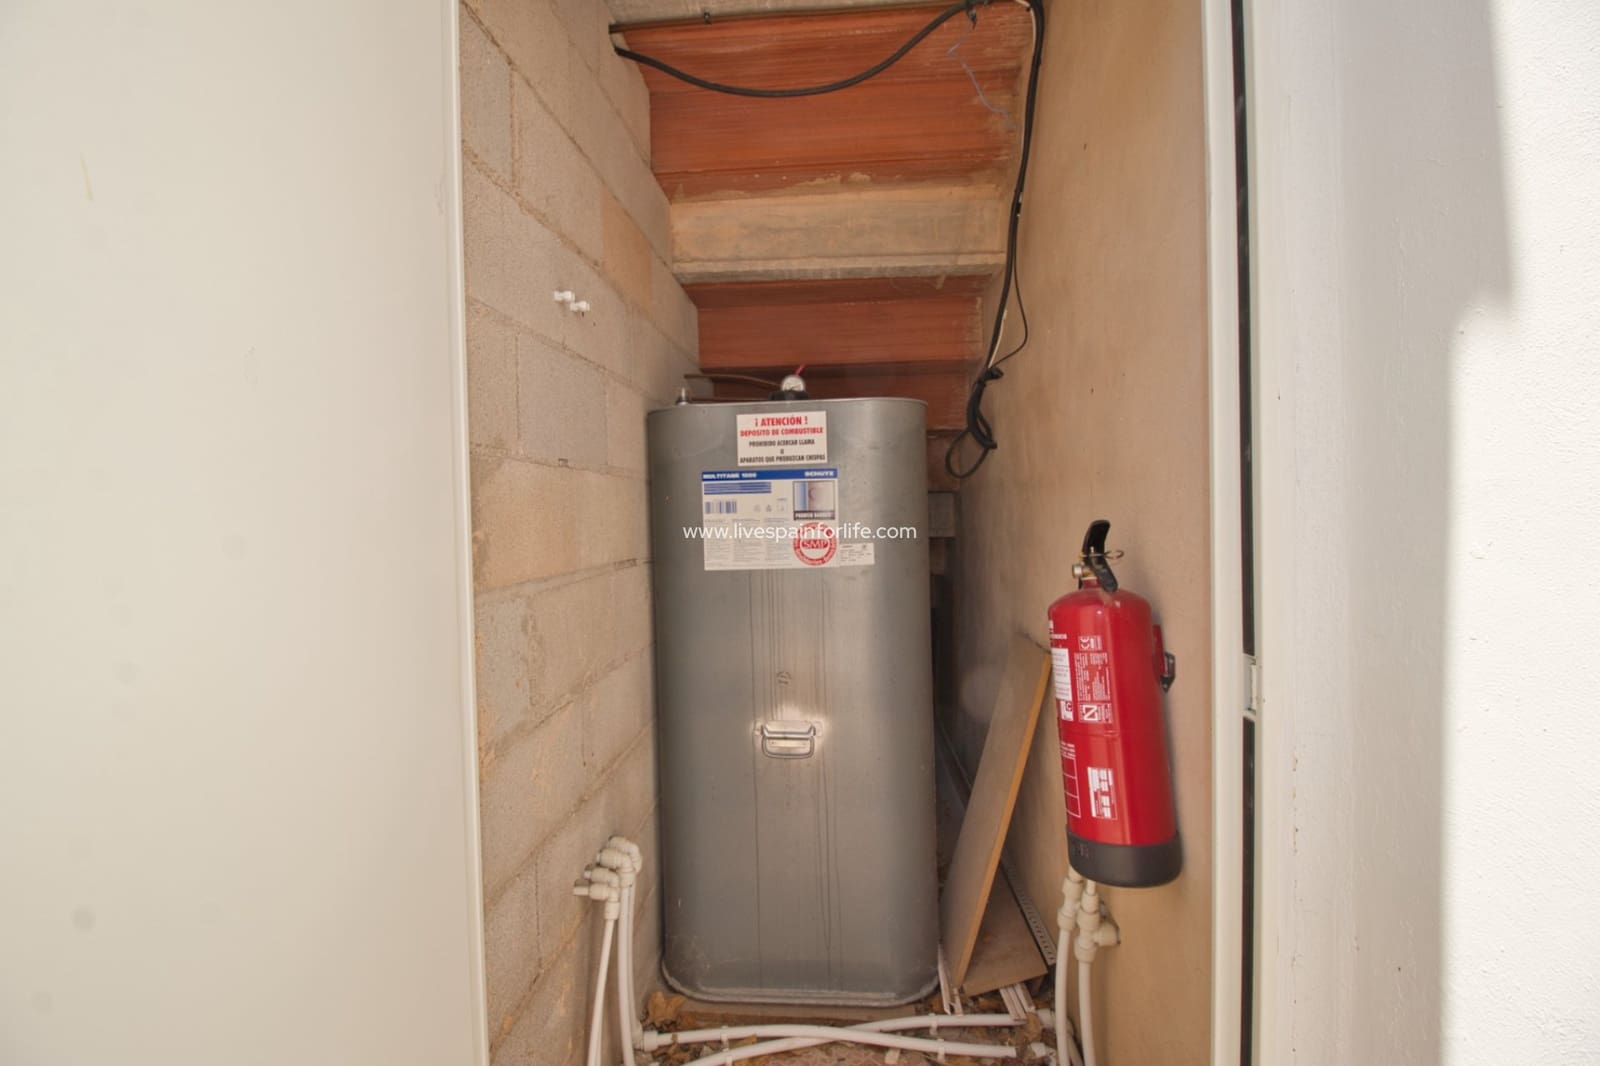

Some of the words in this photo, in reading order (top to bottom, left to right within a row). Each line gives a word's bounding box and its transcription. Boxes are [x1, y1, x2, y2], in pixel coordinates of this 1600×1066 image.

[771, 428, 779, 436] DE
[781, 427, 824, 435] COMBUSTIBLE
[749, 440, 776, 448] PROHIBIDO
